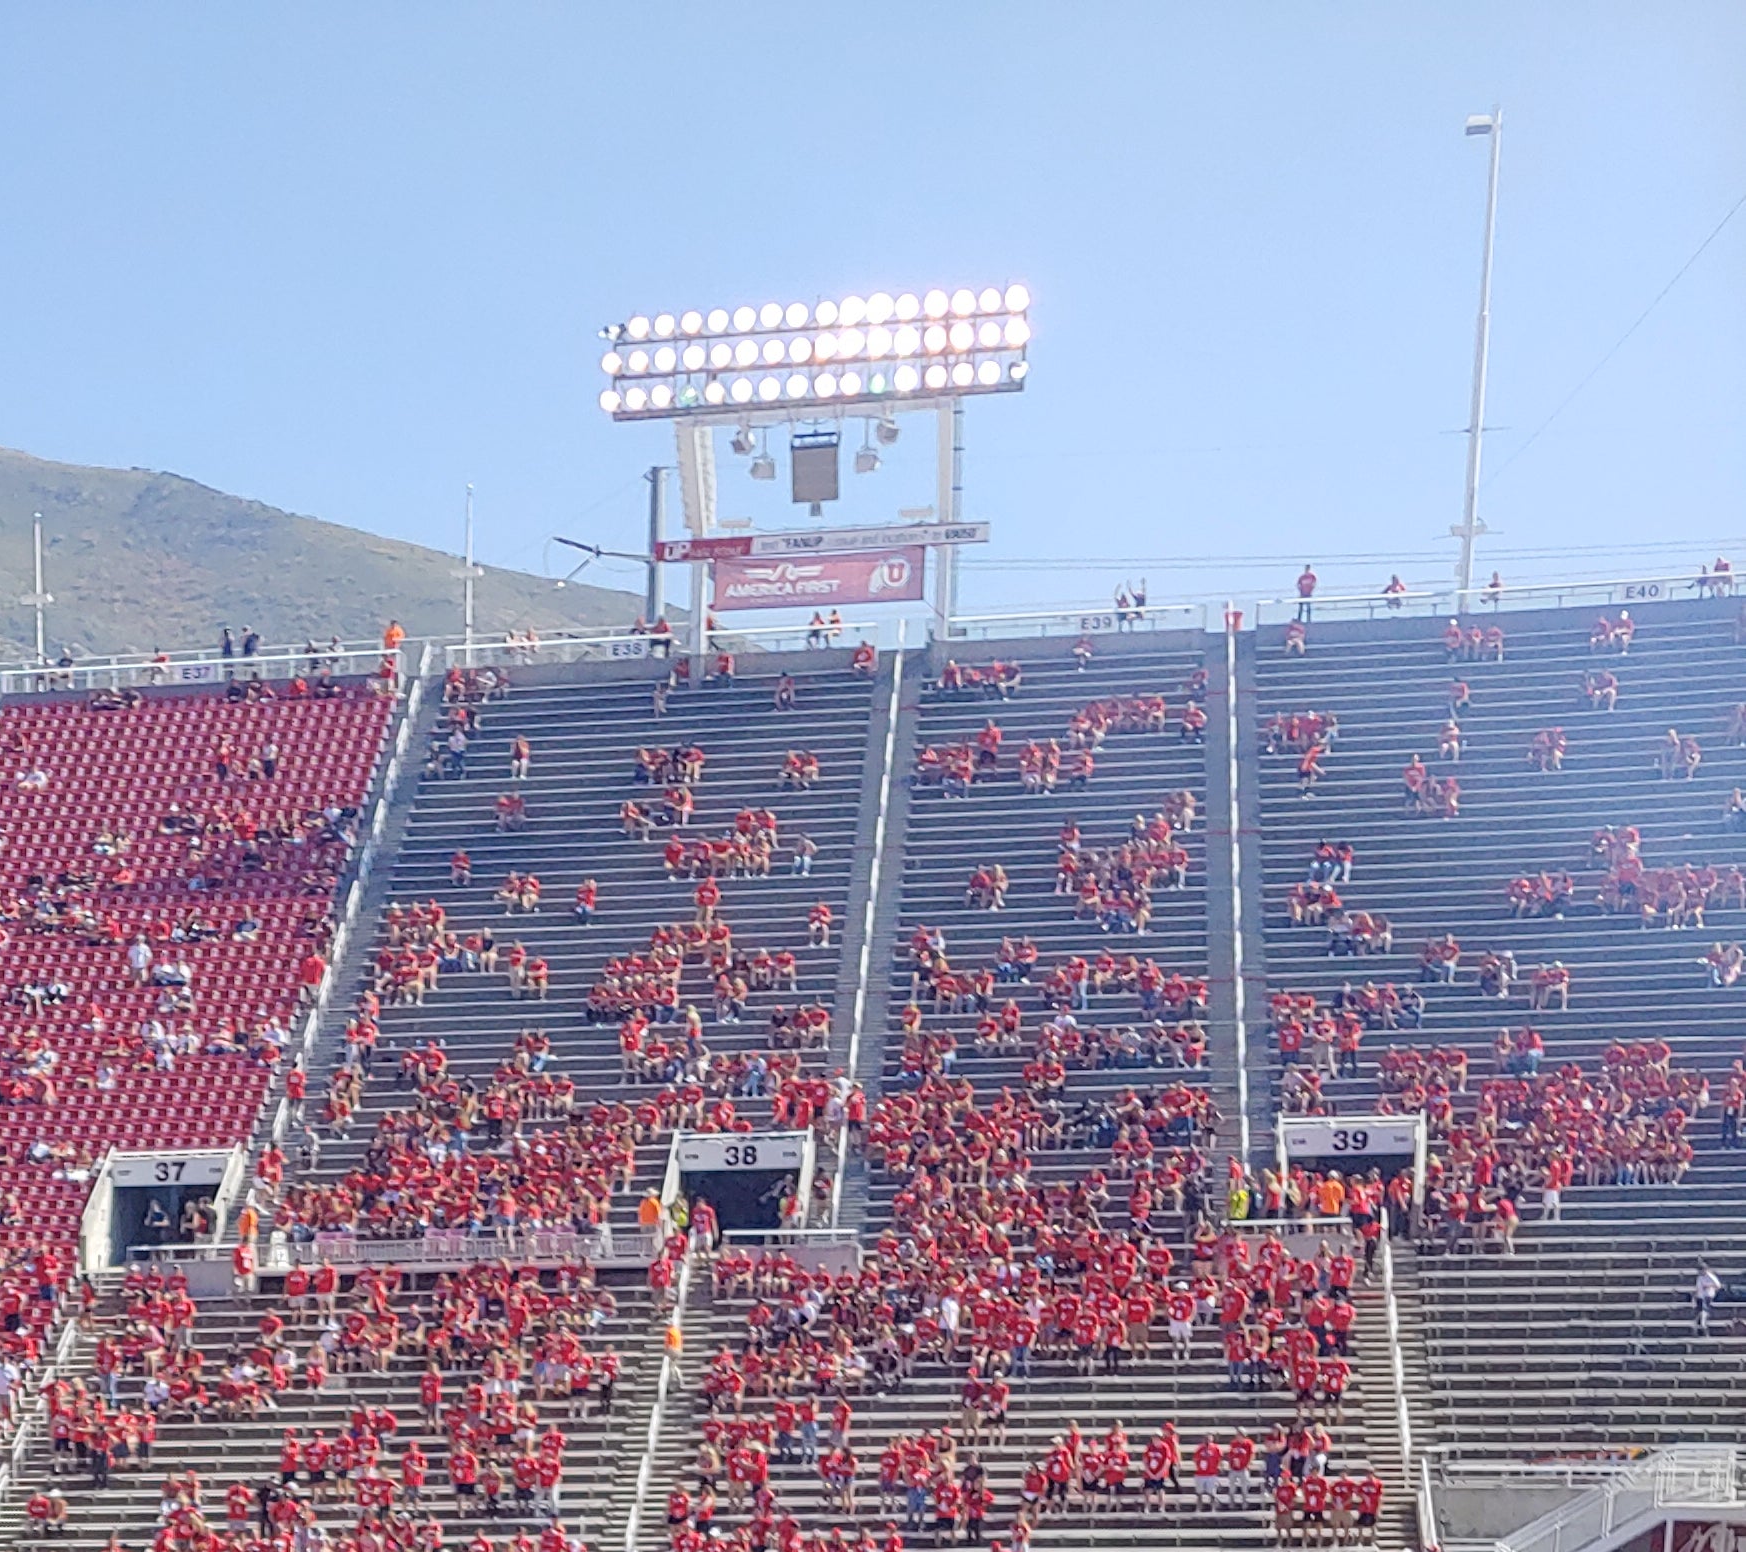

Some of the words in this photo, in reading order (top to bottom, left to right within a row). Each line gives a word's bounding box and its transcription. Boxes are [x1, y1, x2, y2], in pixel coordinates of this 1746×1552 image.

[724, 582, 794, 598] AMERICA
[794, 579, 841, 594] FIRST
[1626, 585, 1659, 598] E40
[1081, 617, 1111, 629] E39
[182, 667, 211, 679] E37
[1332, 1130, 1369, 1151] 39
[724, 1145, 757, 1166] 38
[155, 1161, 186, 1182] 37
